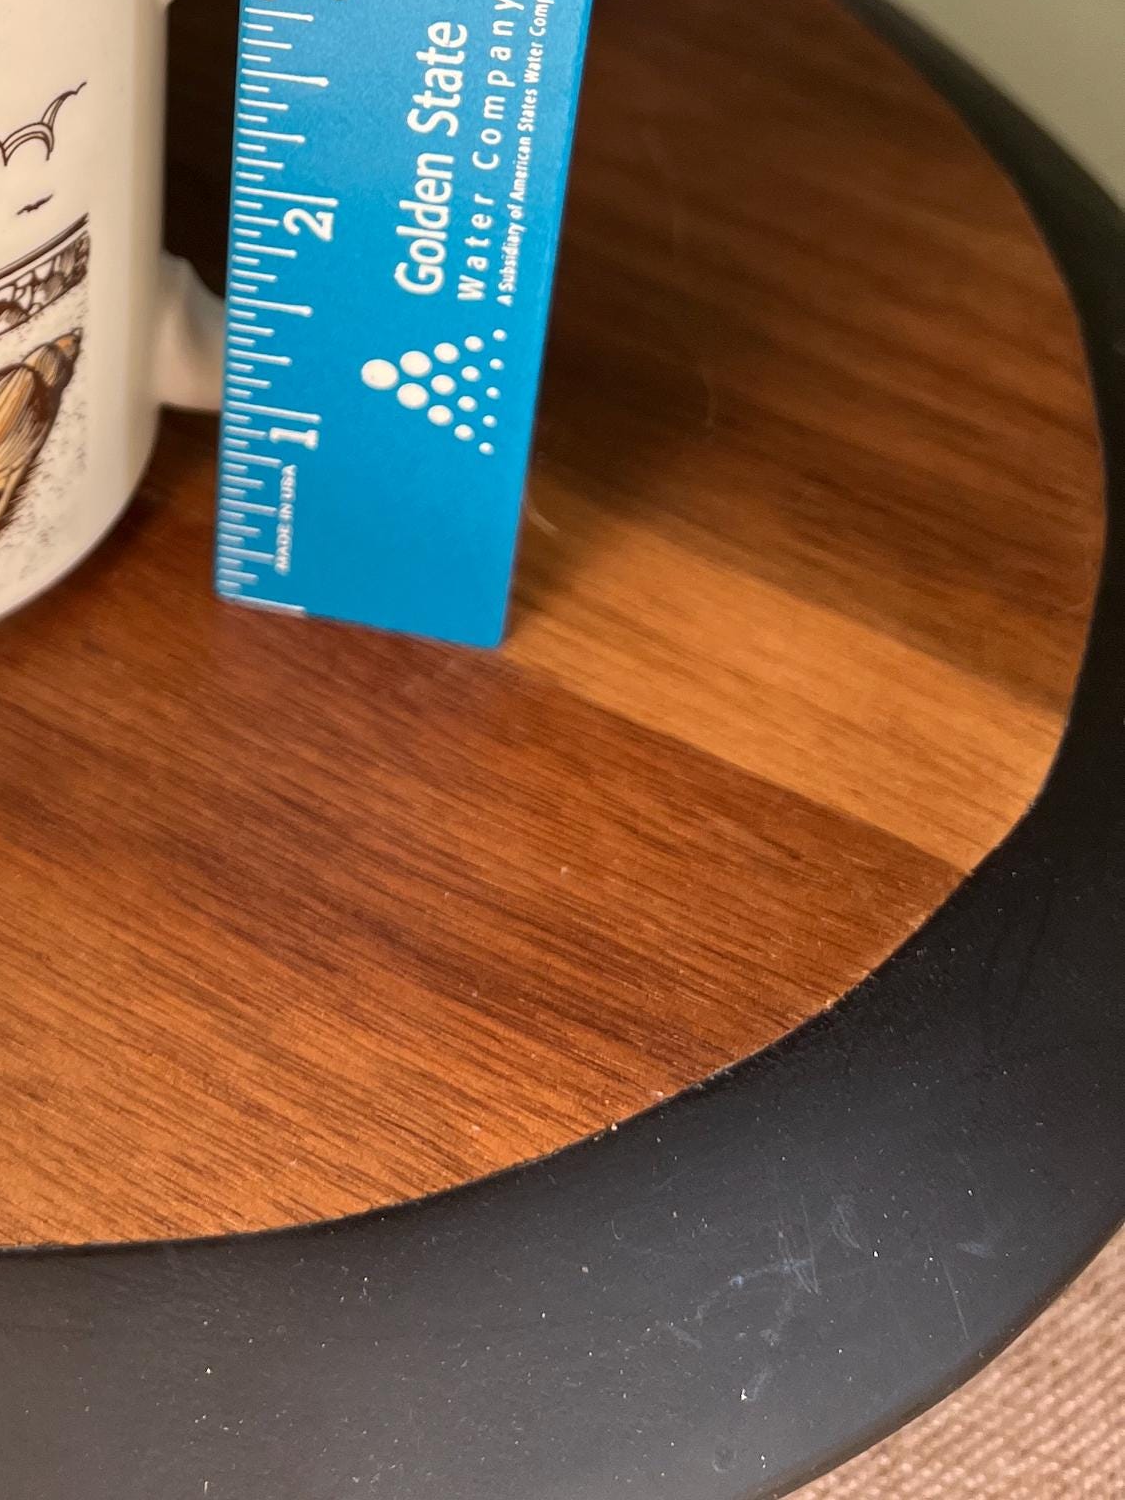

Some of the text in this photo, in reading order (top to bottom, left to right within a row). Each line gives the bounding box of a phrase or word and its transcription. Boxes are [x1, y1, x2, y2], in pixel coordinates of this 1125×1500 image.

[523, 41, 544, 84] Water
[516, 88, 539, 133] States
[394, 21, 468, 295] Golden State
[509, 136, 532, 202] American
[283, 209, 334, 241] 2
[506, 203, 524, 220] of
[457, 192, 494, 301] Water
[498, 222, 526, 292] Subsidiary
[497, 295, 513, 306] A
[269, 427, 320, 450] 1
[273, 464, 296, 574] MADE IN USA
